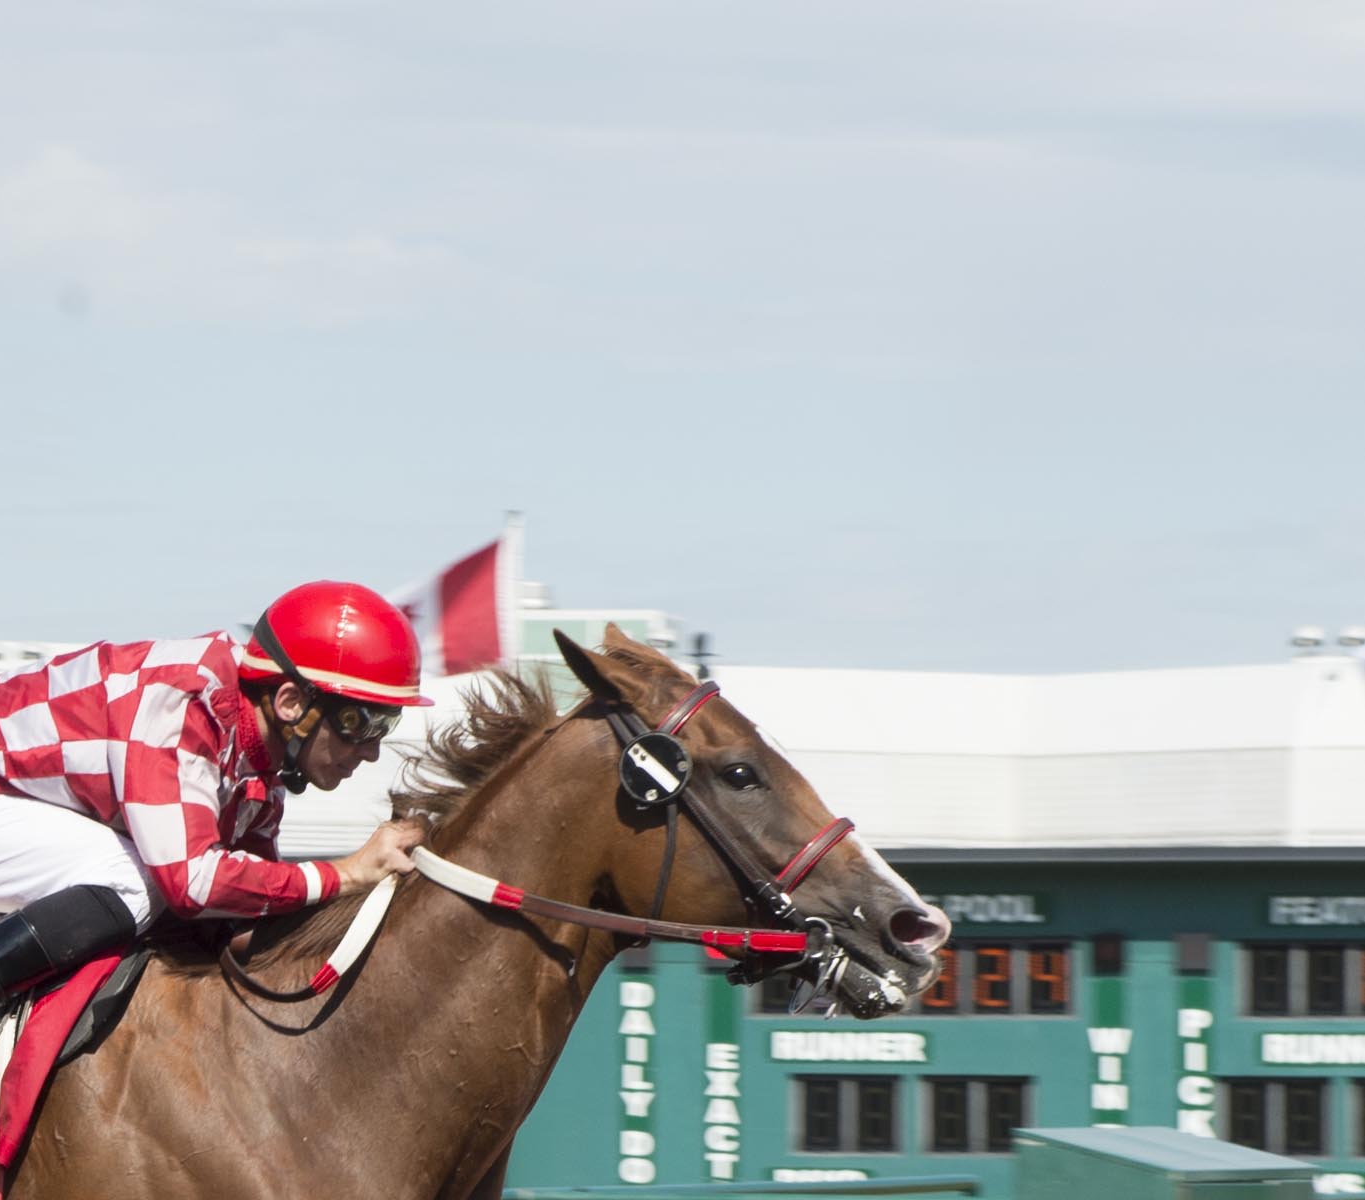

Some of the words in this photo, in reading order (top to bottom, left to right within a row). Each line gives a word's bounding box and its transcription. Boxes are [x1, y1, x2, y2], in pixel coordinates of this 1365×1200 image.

[942, 895, 1045, 923] POOL
[618, 982, 656, 1117] DAILY
[770, 1031, 928, 1061] RUNNER
[1088, 1028, 1133, 1110] WIN
[1177, 1009, 1216, 1138] PICK
